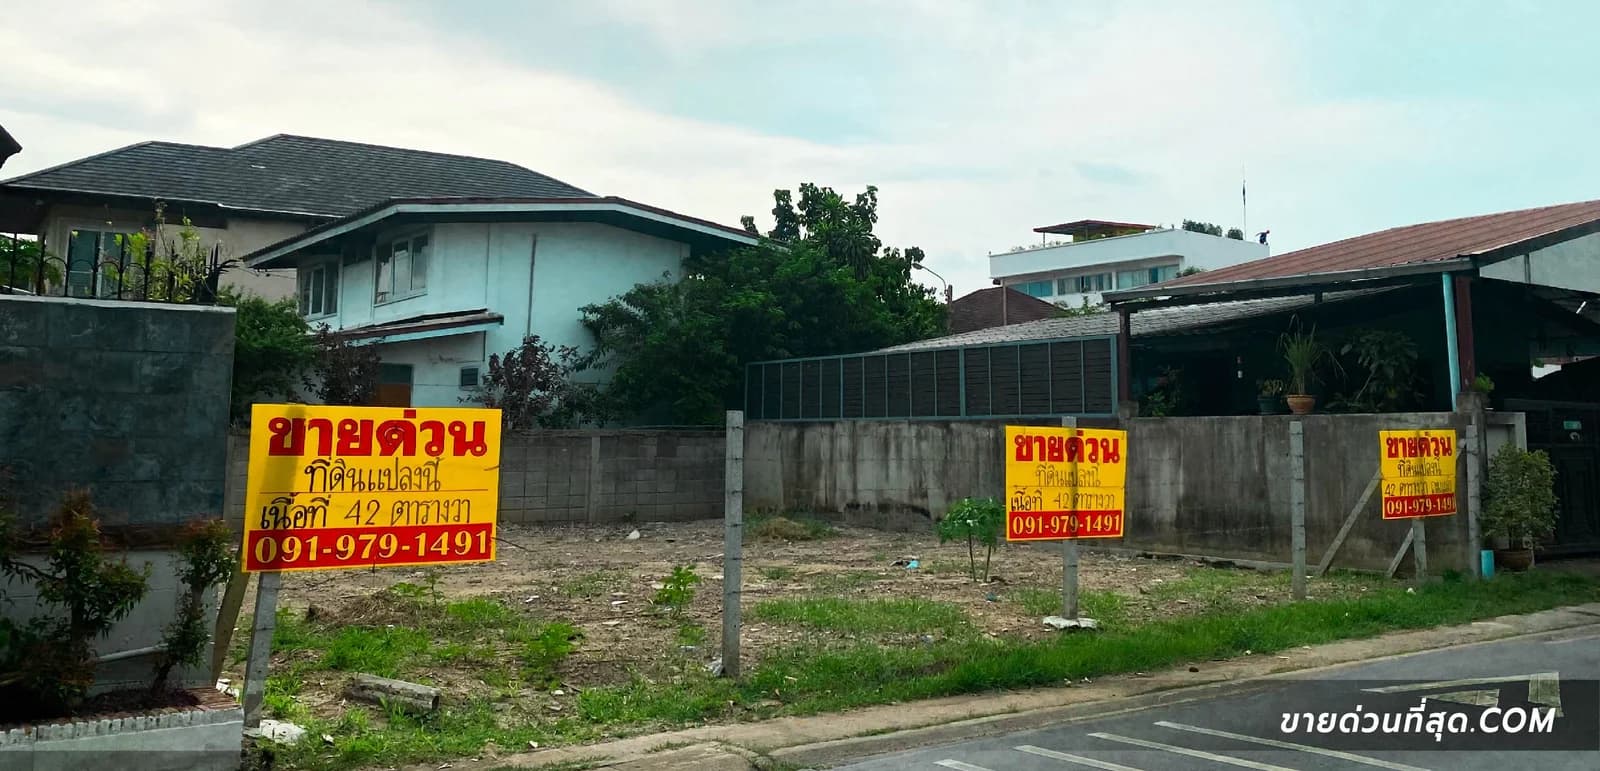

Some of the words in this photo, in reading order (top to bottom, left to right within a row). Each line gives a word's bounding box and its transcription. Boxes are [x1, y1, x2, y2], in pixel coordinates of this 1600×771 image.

[268, 409, 487, 457] ขายด่วน
[1386, 432, 1452, 458] ขายด่วน
[1014, 430, 1120, 463] ขายด่วน
[1011, 485, 1043, 511] เนื้อที่
[1053, 492, 1070, 509] 42
[1072, 492, 1115, 509] ตารางวา
[1384, 484, 1396, 496] 42
[260, 492, 332, 529] เนื้อที่
[344, 499, 381, 525] 42
[391, 498, 471, 526] ตารางวา
[1387, 496, 1455, 514] 091-979-1491
[1013, 514, 1120, 535] 091-979-1491
[255, 529, 487, 564] 091-979-1491
